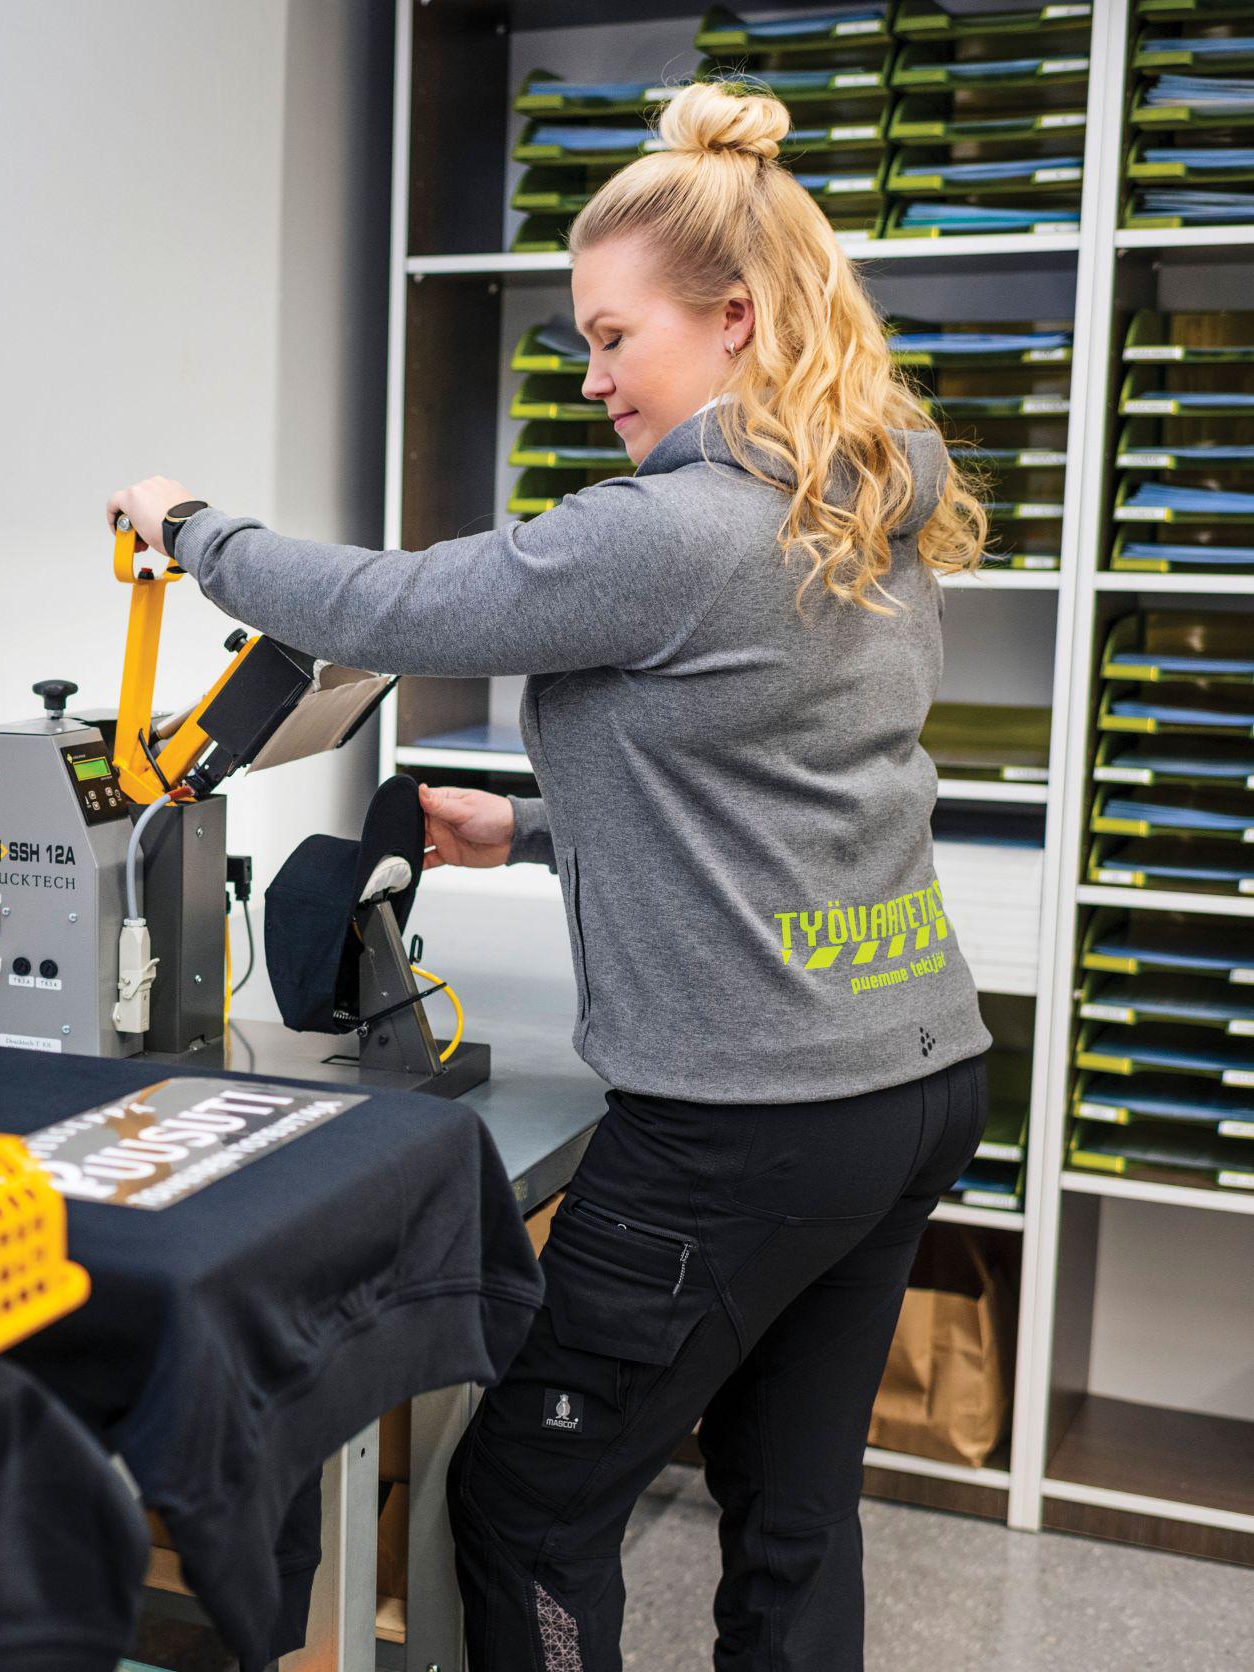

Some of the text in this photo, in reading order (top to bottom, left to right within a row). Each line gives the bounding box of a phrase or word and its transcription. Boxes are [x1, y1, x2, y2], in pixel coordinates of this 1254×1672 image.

[9, 842, 76, 866] SSH 12A
[850, 968, 909, 995] puemme
[546, 1418, 578, 1429] MASCOT
